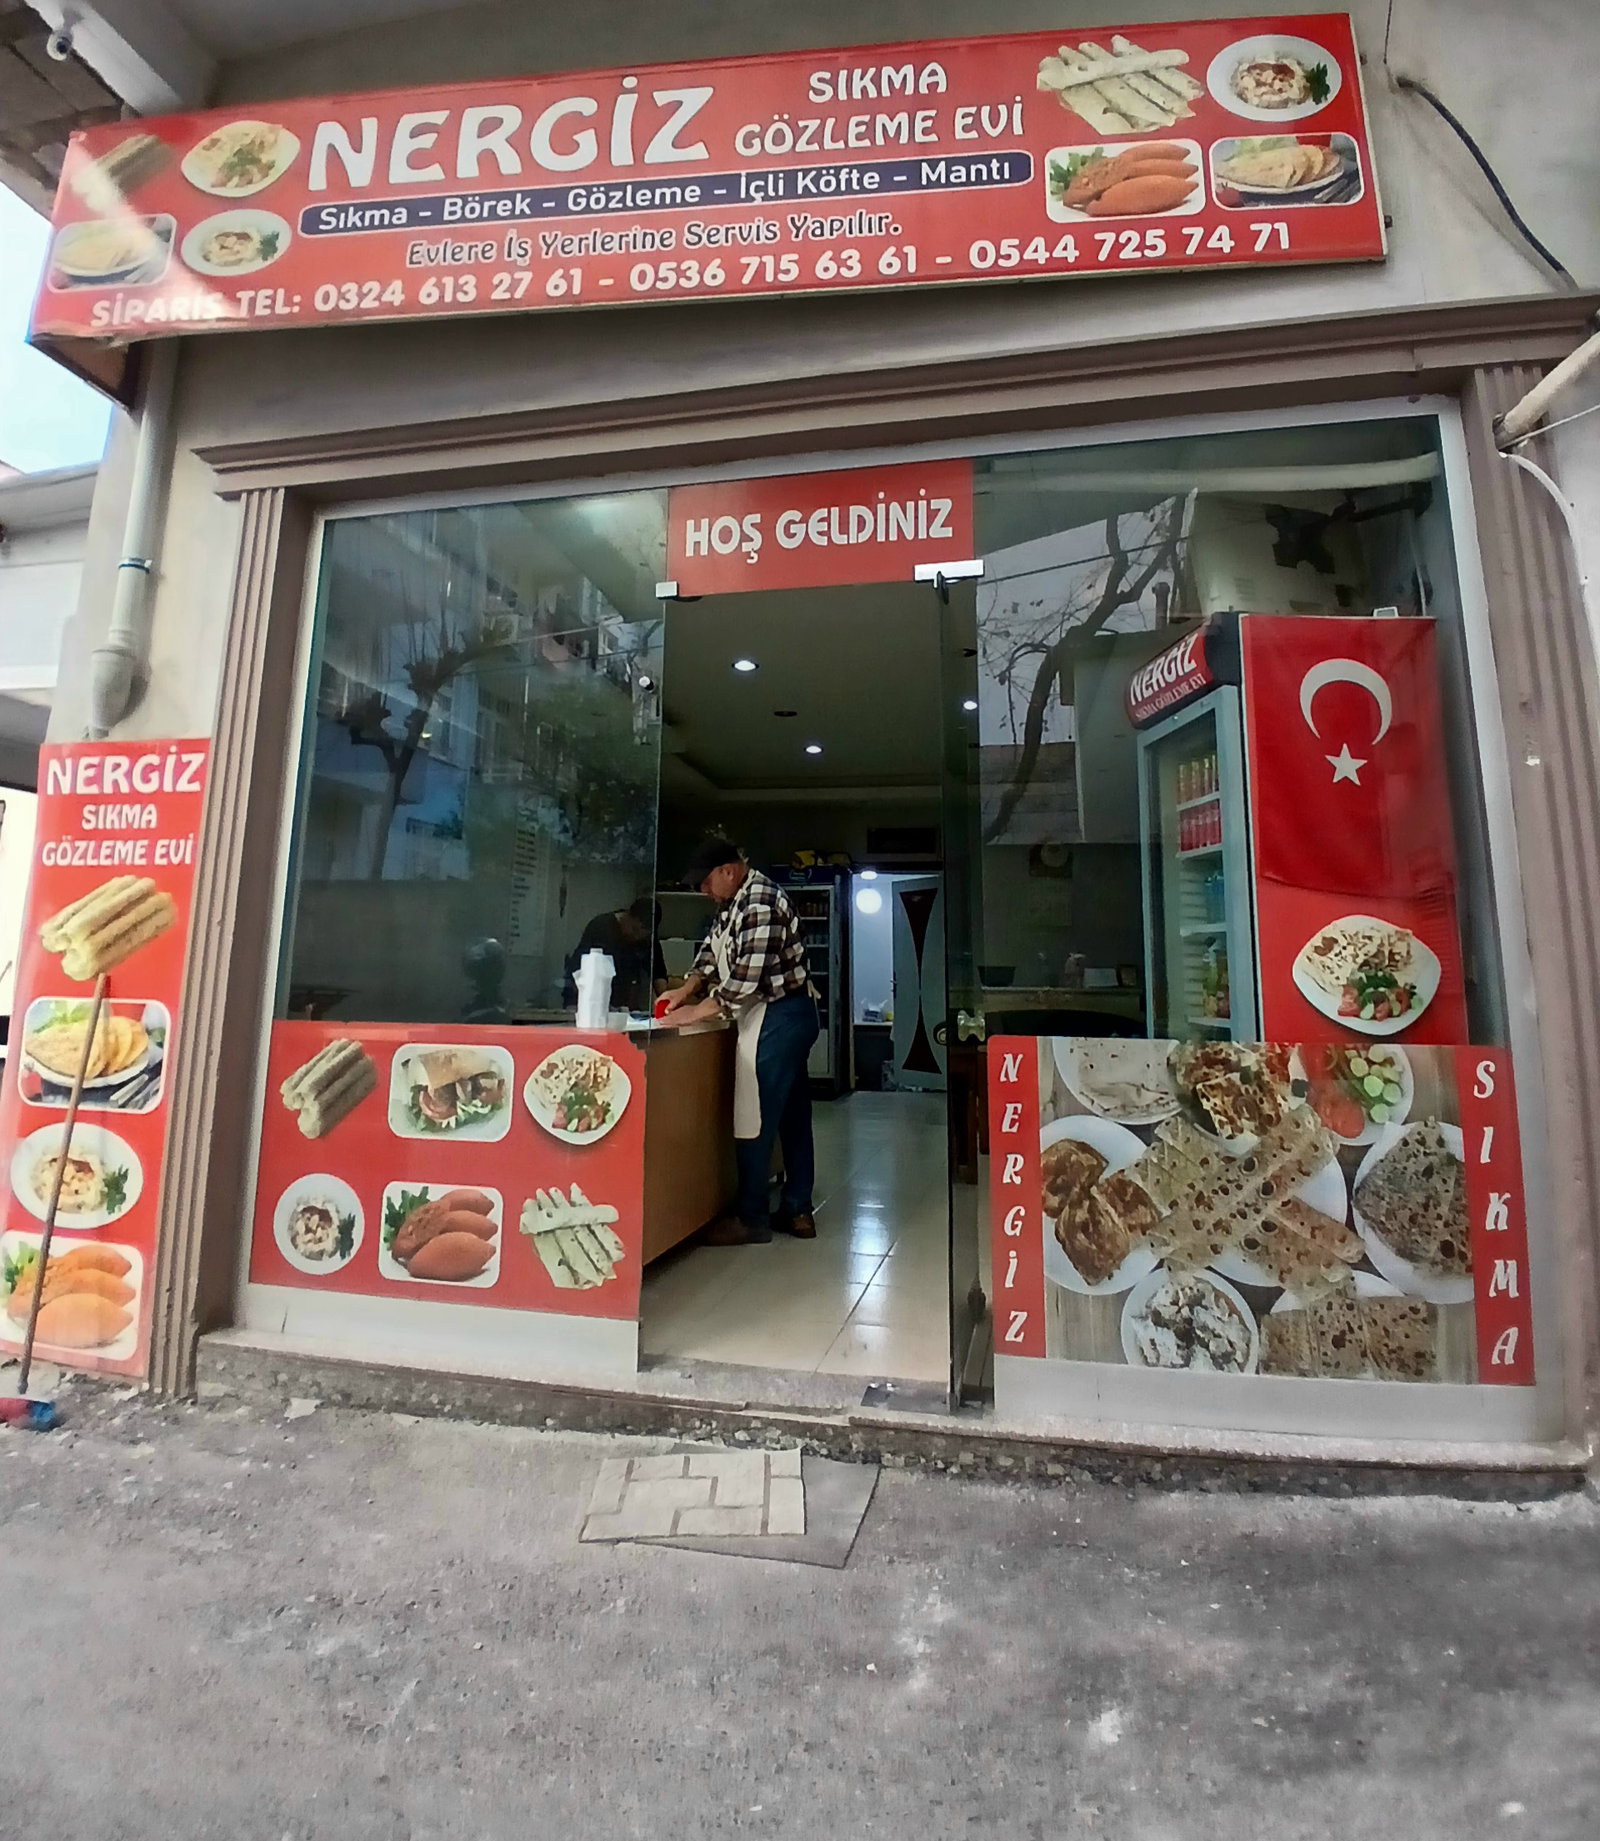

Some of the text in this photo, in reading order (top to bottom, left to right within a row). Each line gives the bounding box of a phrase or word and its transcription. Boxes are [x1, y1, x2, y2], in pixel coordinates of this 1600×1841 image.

[809, 62, 947, 103] SIKMA
[308, 76, 714, 192] NERGİZ
[735, 96, 1023, 156] GÖZLEME EVİ
[318, 206, 408, 231] Sıkma
[443, 193, 532, 221] Börek
[567, 185, 701, 212] Gözleme
[740, 172, 784, 203] İçli
[797, 168, 880, 195] Köfte
[921, 161, 1010, 185] Mantı
[407, 210, 902, 267] Evlere İş Yerlerine Servis Yapılır.
[236, 288, 301, 318] TEL:
[314, 280, 405, 312] 0324
[418, 276, 477, 305] 613
[491, 271, 533, 300] 27
[545, 268, 583, 297] 61
[629, 258, 725, 292] 0536
[740, 253, 800, 285] 715
[815, 249, 862, 279] 63
[878, 245, 917, 276] 61
[968, 234, 1079, 269] 0544
[1094, 228, 1166, 261] 725
[1182, 224, 1235, 257] 74
[1249, 221, 1290, 252] 71
[685, 488, 953, 564] HOŞ GELDİNİZ
[47, 745, 205, 795] NERGİZ
[81, 803, 158, 830] SIKMA
[42, 832, 194, 866] GÖZLEME EVİ
[1474, 1060, 1519, 1365] SIKMA
